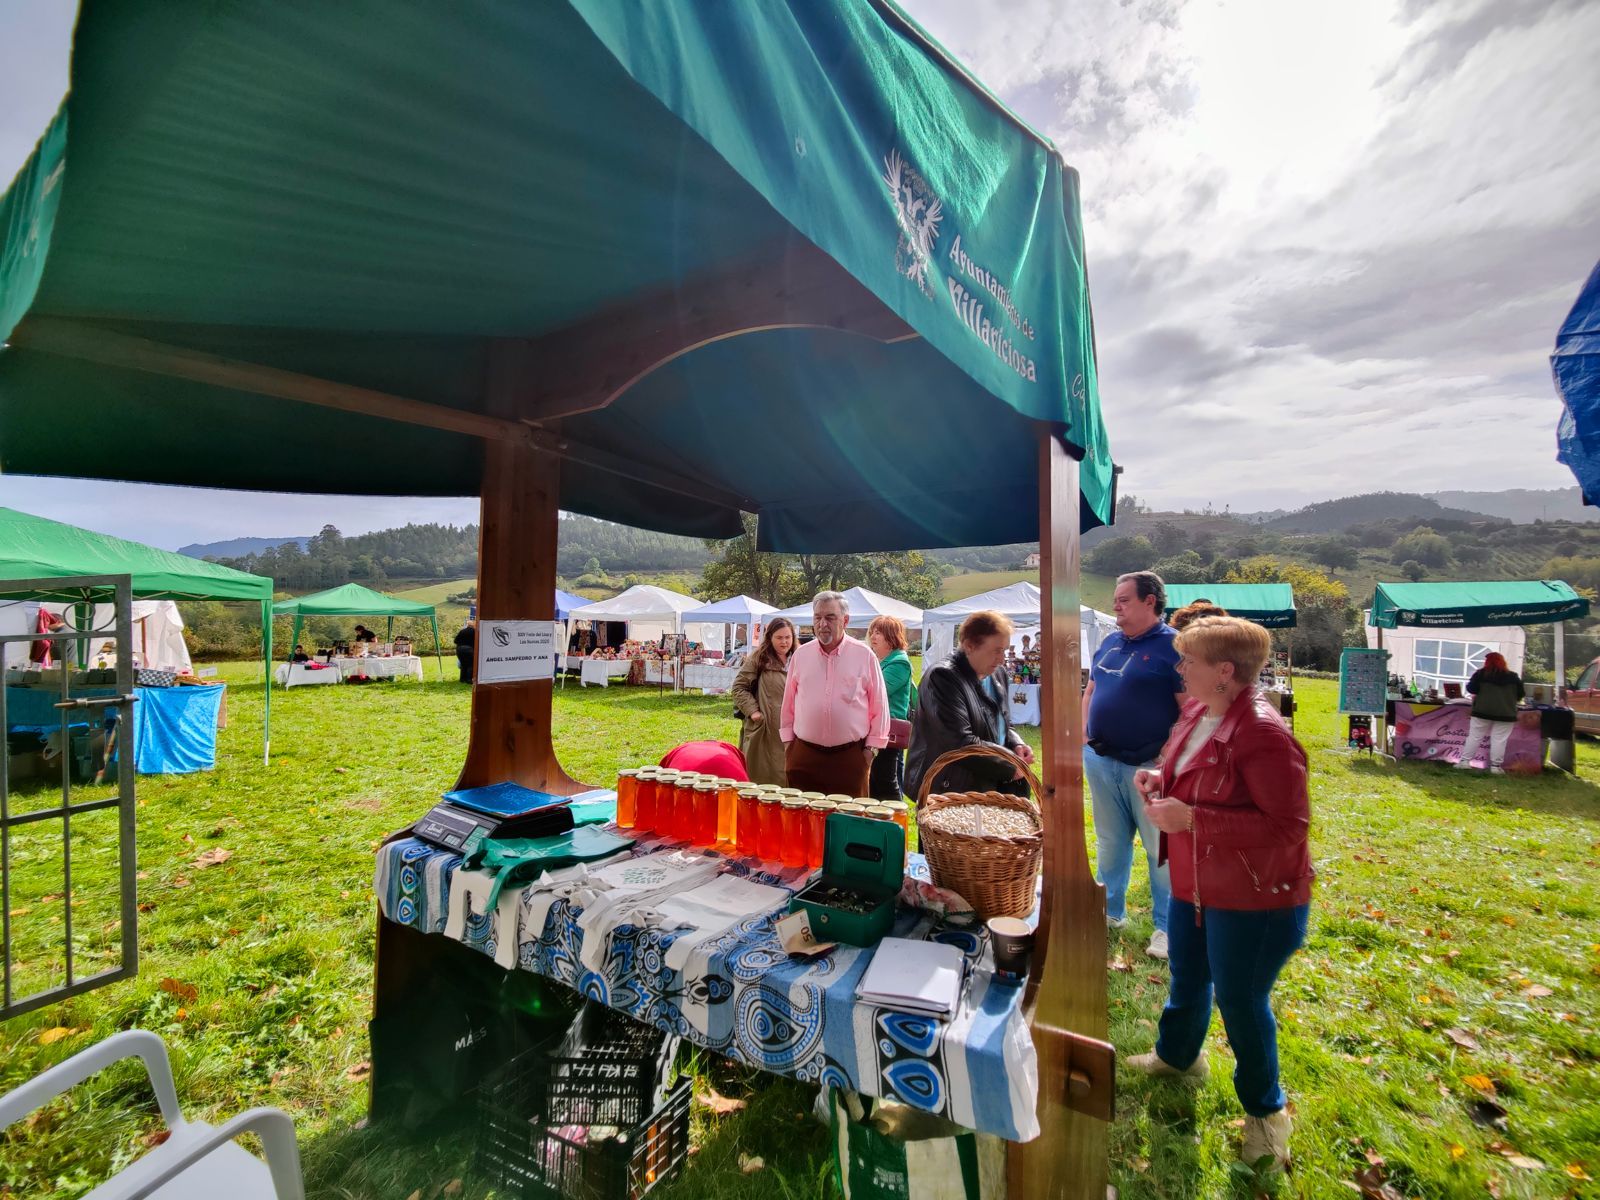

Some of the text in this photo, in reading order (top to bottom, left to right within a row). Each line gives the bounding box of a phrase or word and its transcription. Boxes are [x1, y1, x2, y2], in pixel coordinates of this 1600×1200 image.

[947, 275, 1038, 383] Villaviciosa
[1022, 316, 1035, 341] de
[1436, 724, 1469, 737] Costu
[800, 926, 813, 943] 50
